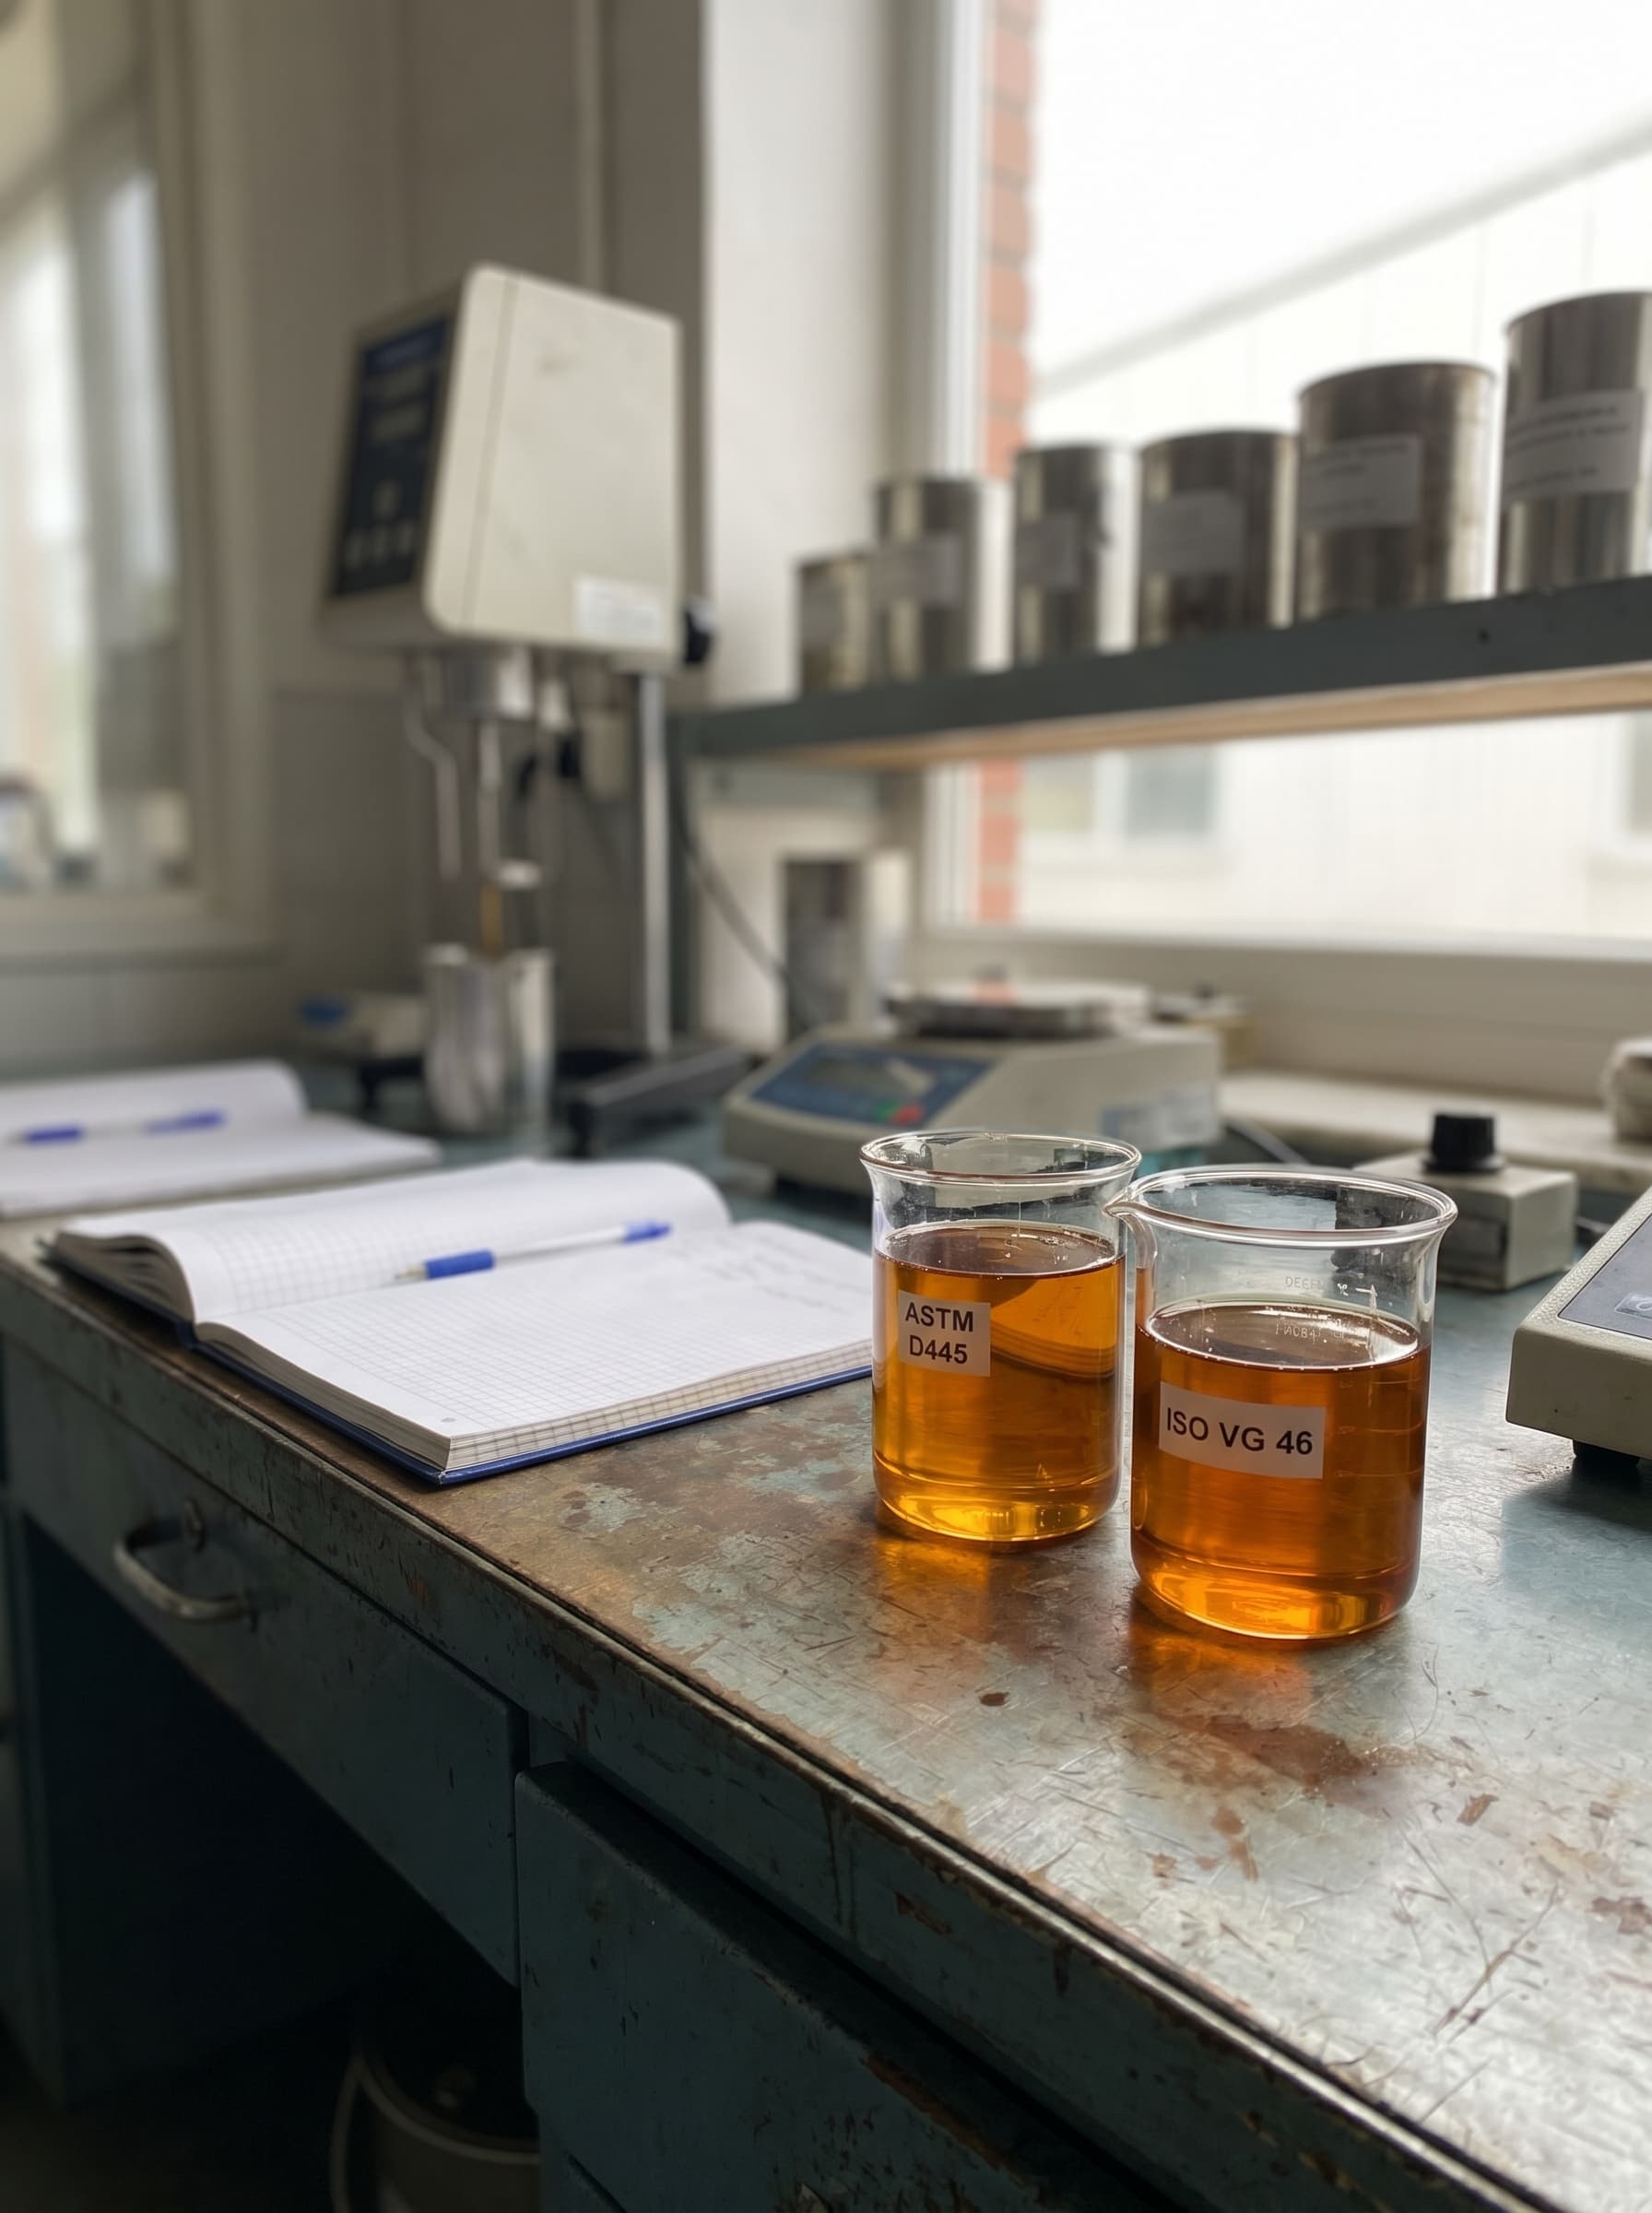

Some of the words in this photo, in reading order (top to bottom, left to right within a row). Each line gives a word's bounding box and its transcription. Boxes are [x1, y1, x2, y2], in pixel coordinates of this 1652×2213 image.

[905, 1302, 974, 1332] ASTM
[910, 1335, 968, 1365] D445
[1167, 1407, 1210, 1441] ISO
[1219, 1421, 1266, 1452] VG
[1275, 1430, 1314, 1455] 46
